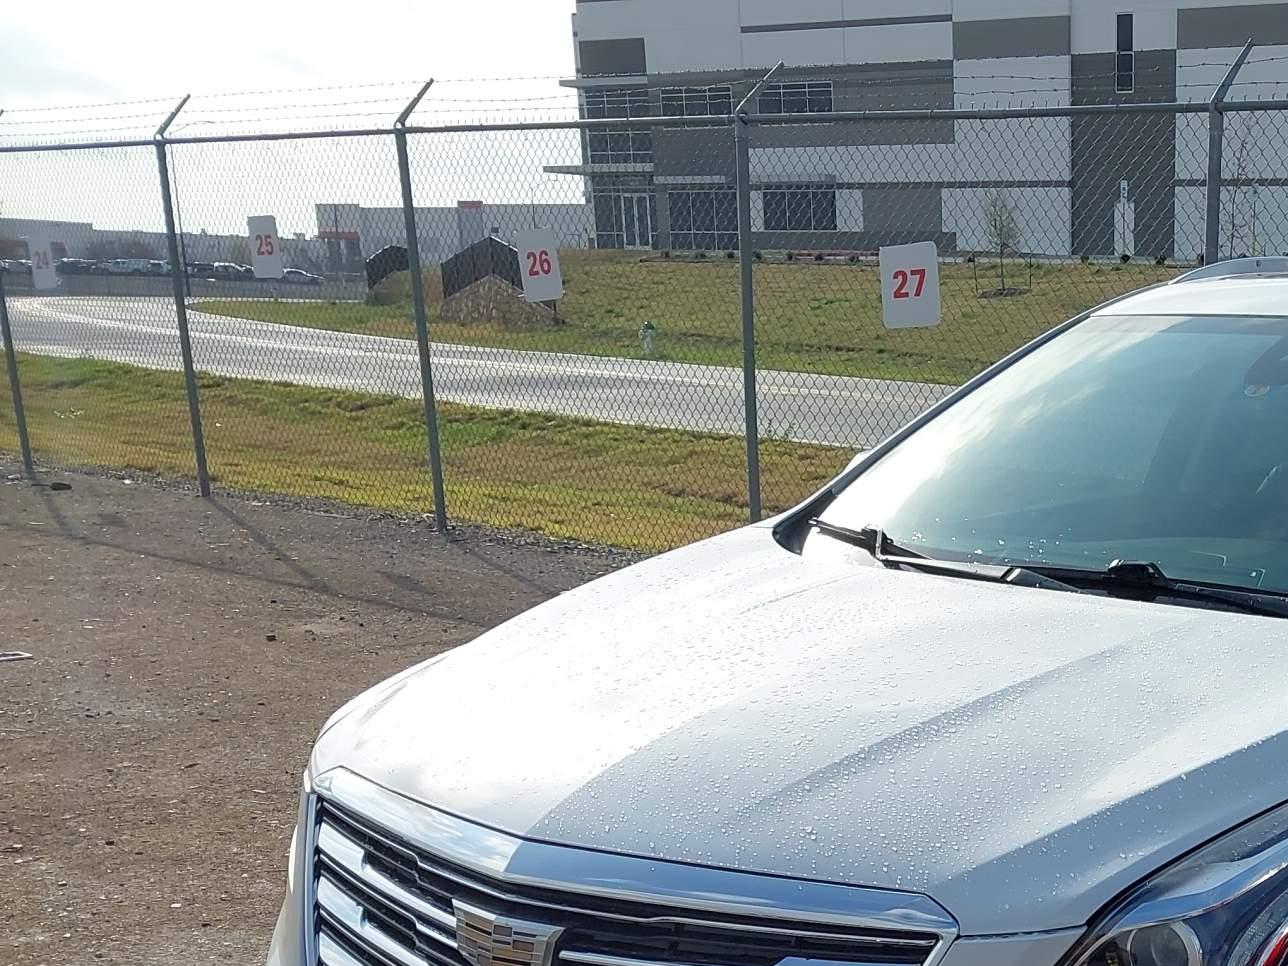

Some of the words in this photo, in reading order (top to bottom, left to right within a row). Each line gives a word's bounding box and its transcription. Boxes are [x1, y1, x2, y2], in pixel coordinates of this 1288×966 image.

[255, 234, 274, 256] 25
[33, 250, 50, 270] 24
[526, 250, 552, 276] 26
[892, 268, 926, 299] 27
